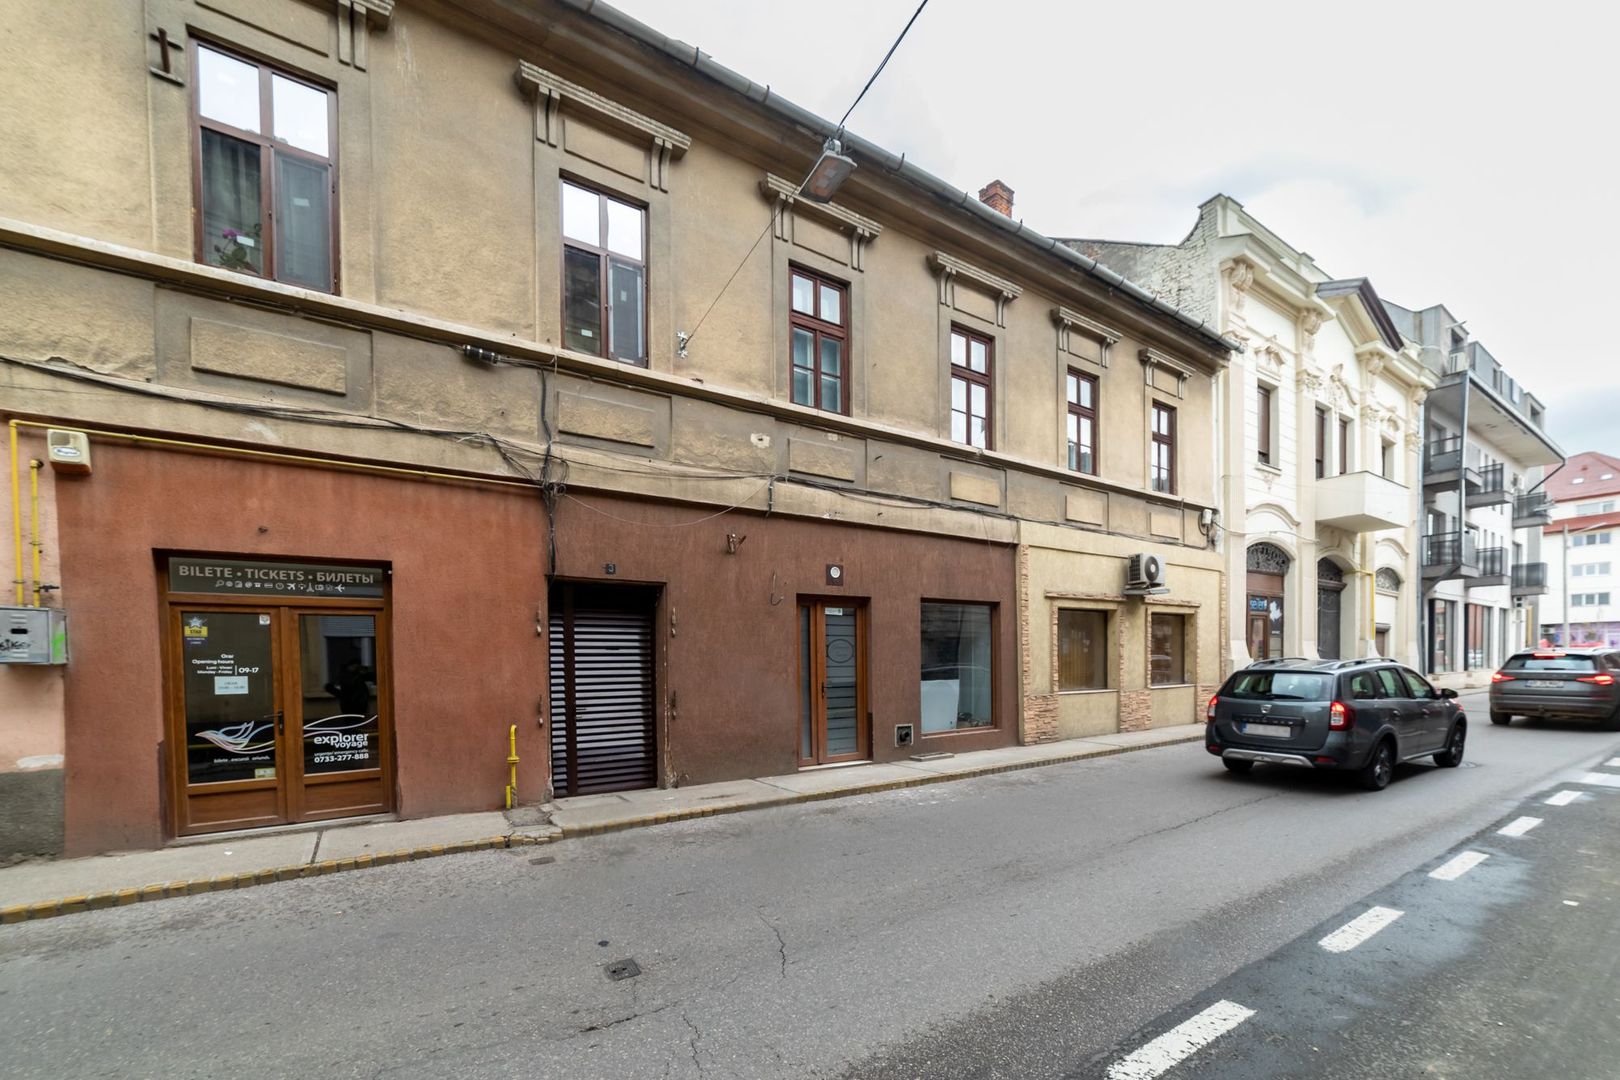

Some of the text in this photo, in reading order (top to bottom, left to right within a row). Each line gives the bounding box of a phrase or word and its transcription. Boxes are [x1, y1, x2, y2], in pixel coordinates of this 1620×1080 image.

[178, 565, 305, 581] BILETE TICKETS
[316, 571, 374, 584] БИЛЕТЫ
[313, 733, 369, 746] explorer
[334, 740, 369, 749] voyage
[314, 752, 369, 763] 0733-277-888
